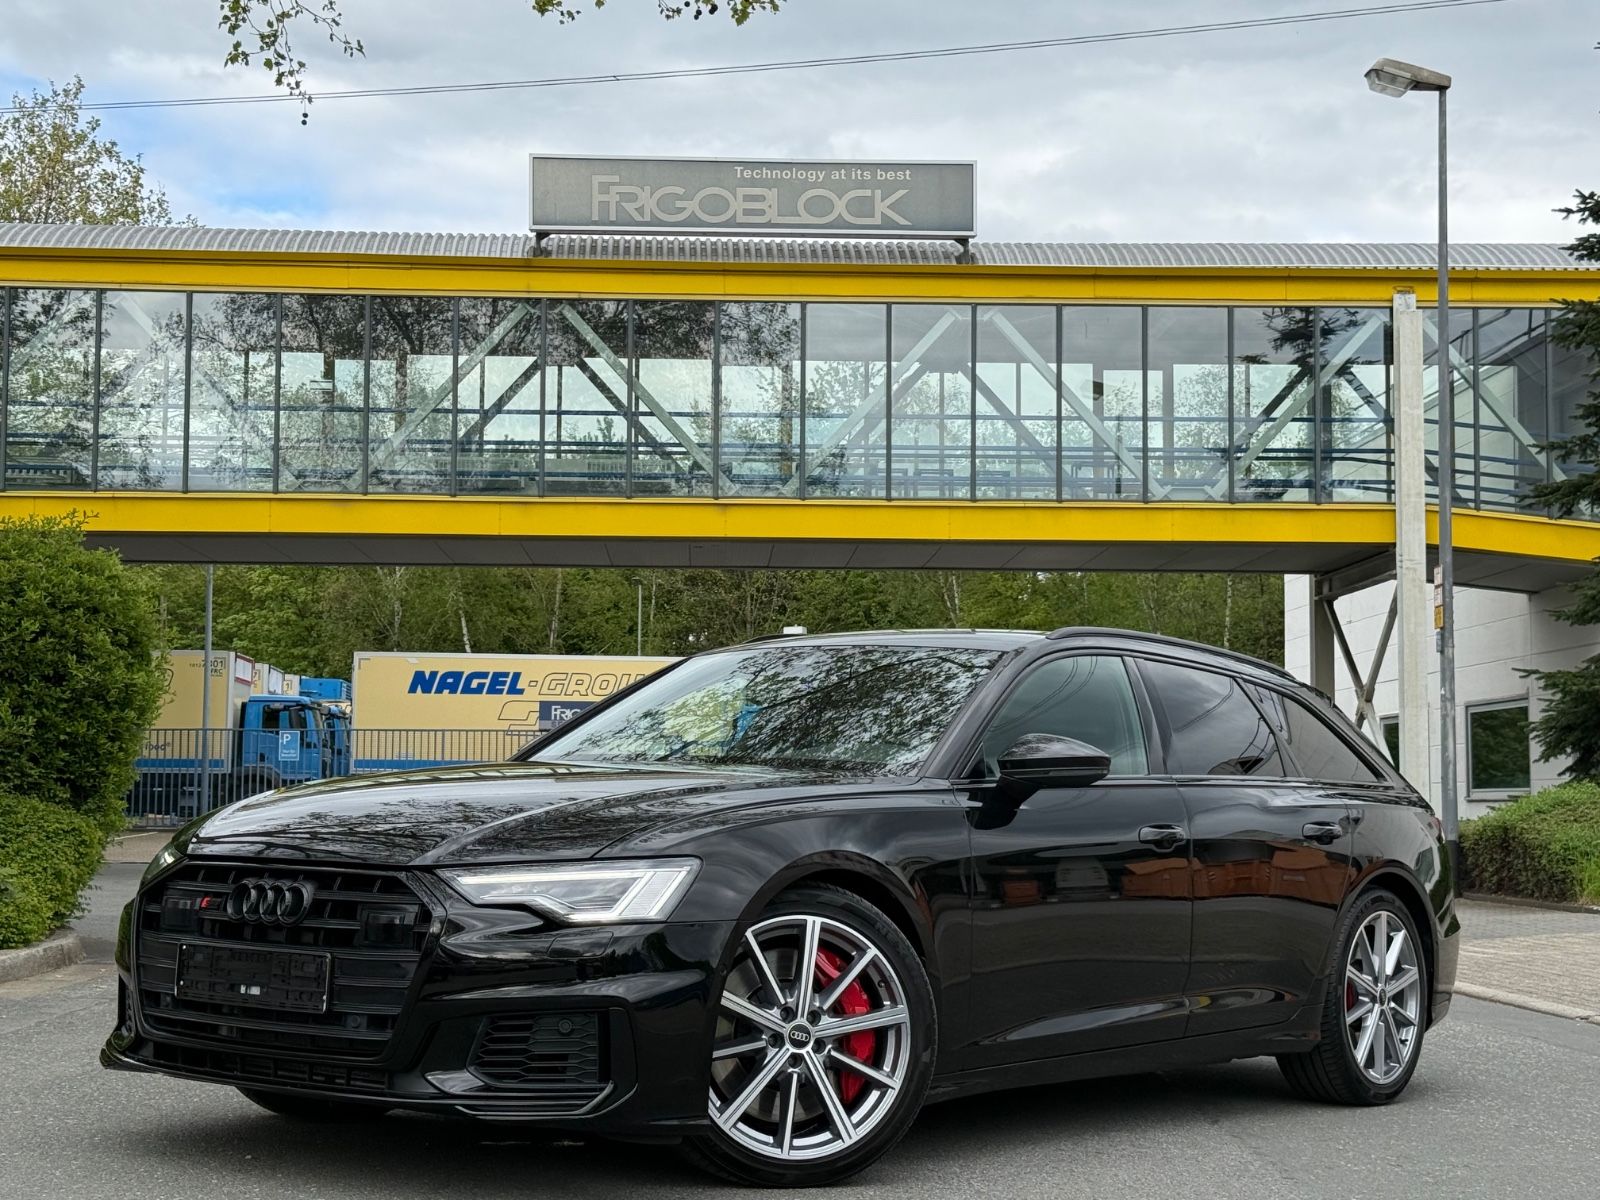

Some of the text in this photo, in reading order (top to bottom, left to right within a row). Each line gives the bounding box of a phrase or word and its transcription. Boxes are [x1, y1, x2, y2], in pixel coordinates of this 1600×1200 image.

[734, 166, 912, 182] Technology at its best
[591, 174, 913, 226] FRIGOBLOCK
[283, 733, 292, 745] P
